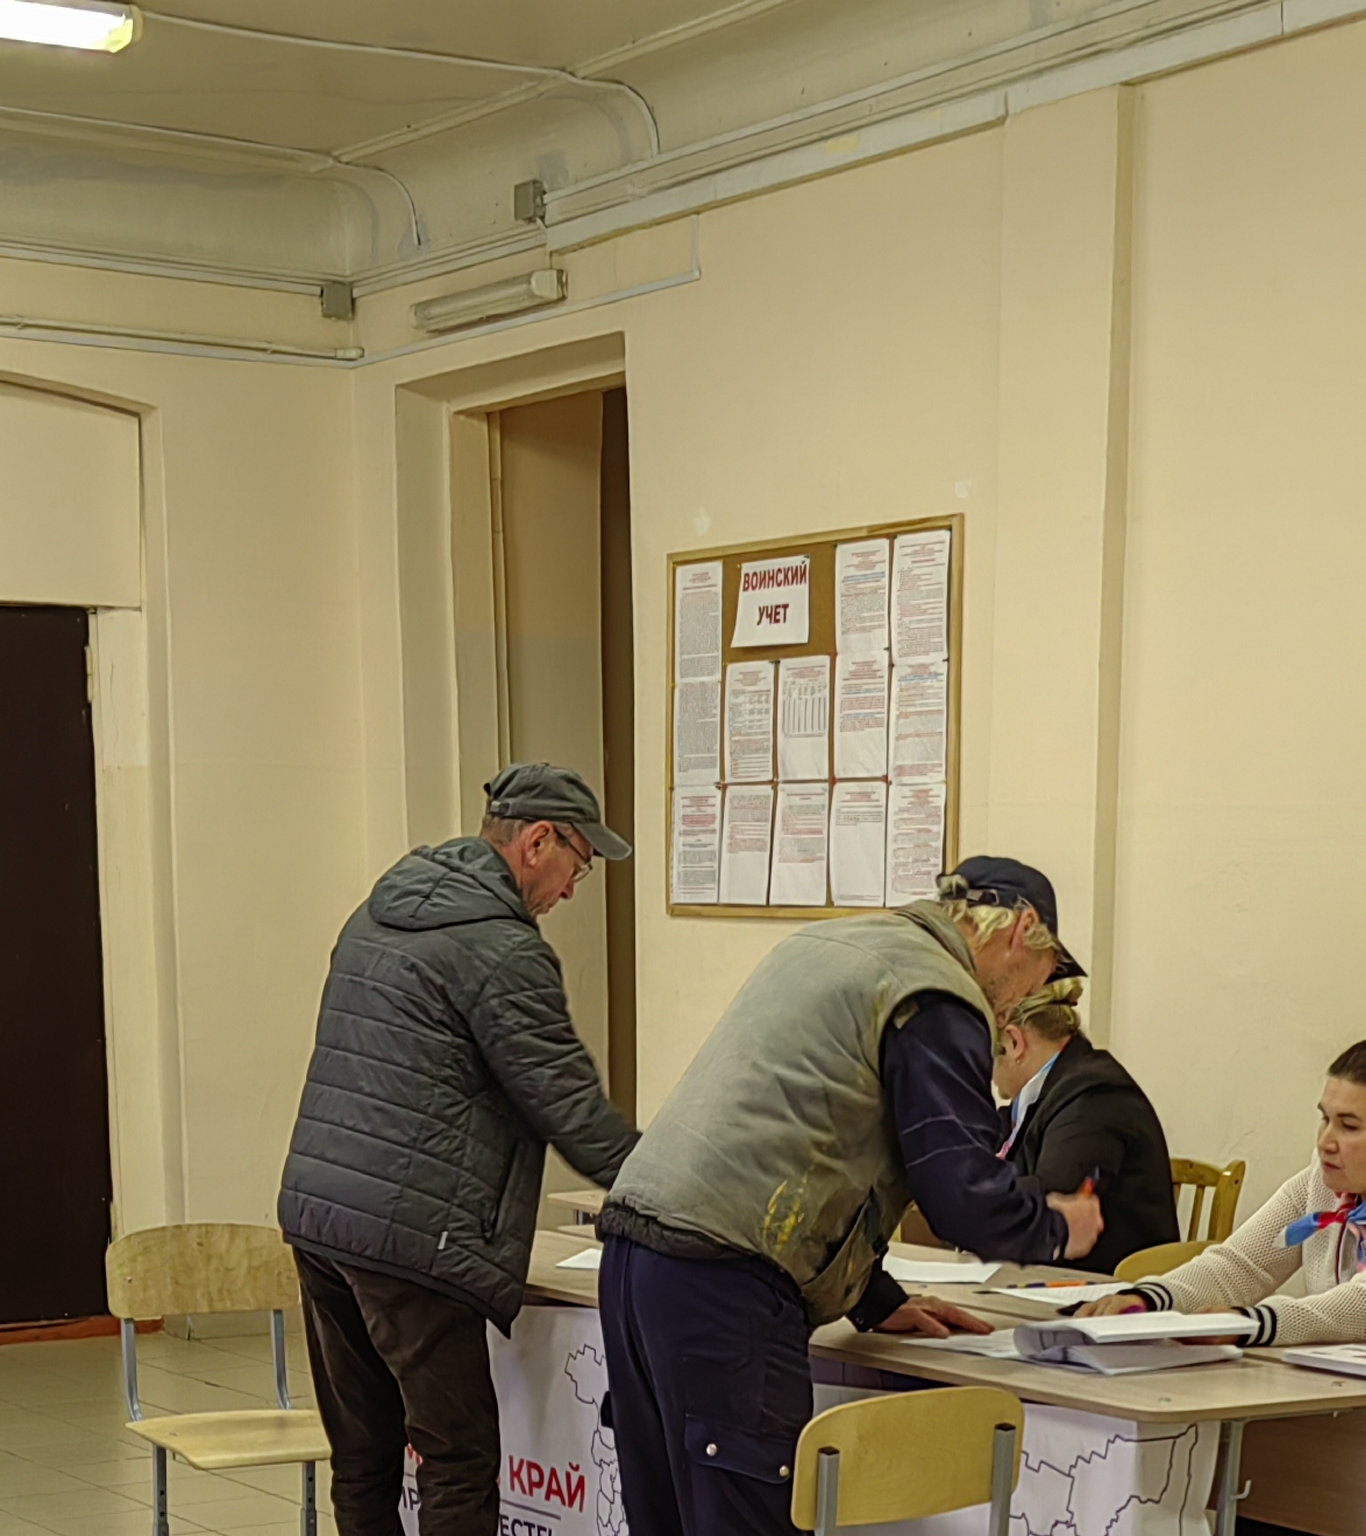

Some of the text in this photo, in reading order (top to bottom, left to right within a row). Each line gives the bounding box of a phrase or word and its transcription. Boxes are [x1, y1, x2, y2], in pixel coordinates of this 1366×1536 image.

[742, 560, 807, 592] ВОИНСКИЙ
[757, 603, 789, 626] УЧЕТ
[508, 1455, 585, 1513] КРАЙ
